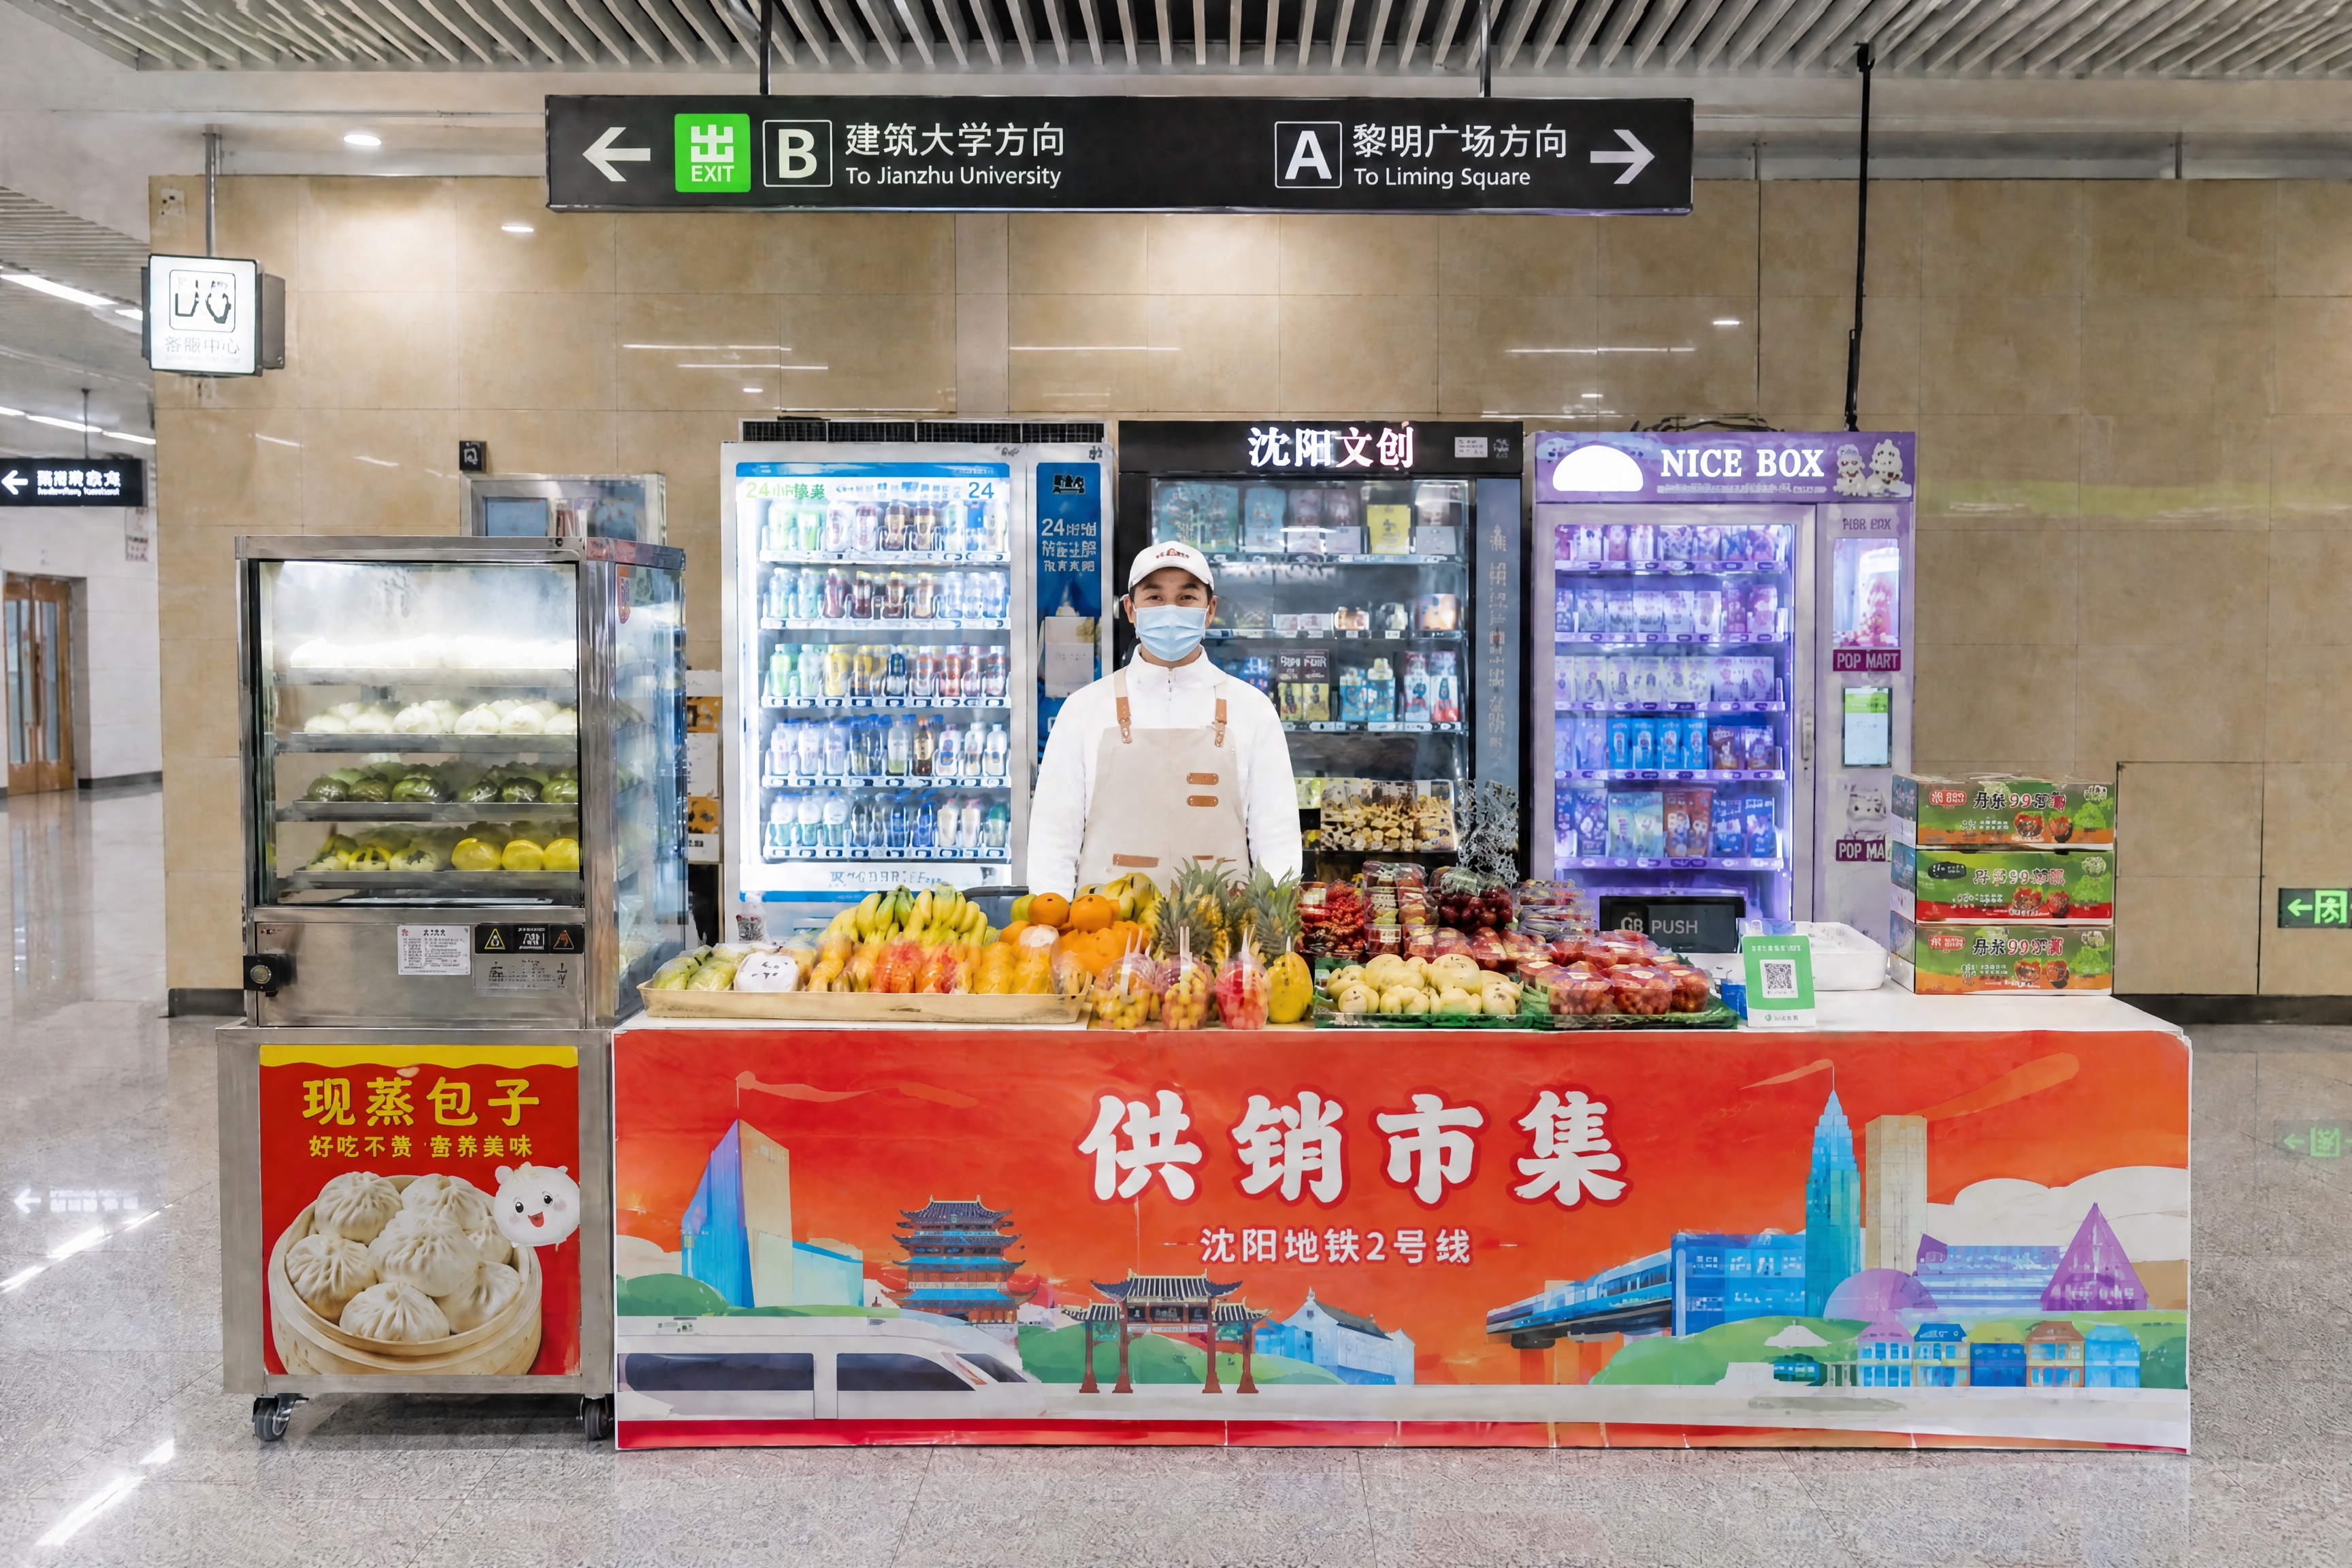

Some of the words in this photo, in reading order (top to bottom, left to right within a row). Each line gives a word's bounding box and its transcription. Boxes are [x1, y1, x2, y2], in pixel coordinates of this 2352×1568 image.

[690, 124, 734, 163] 出
[778, 129, 817, 178] B
[845, 122, 1064, 157] 建筑大学方向
[1284, 130, 1333, 180] A
[1352, 123, 1568, 158] 黎明广场方向
[691, 165, 735, 182] EXIT
[845, 167, 870, 184] To
[877, 165, 953, 184] Jianzhu
[960, 165, 1062, 189] University
[1354, 167, 1379, 185] To
[1386, 167, 1453, 189] Liming
[1461, 167, 1531, 191] Square
[1248, 426, 1414, 469] 沈阳文创
[1661, 448, 1742, 477] NICE
[1756, 448, 1825, 477] BOX
[968, 481, 995, 499] 24
[1838, 653, 1861, 669] POP
[1865, 653, 1899, 669] MART
[1839, 843, 1862, 859] POP
[1651, 919, 1698, 934] PUSH
[302, 1077, 540, 1127] 现蒸包子
[1078, 1089, 1627, 1206] 供销市集
[1200, 1228, 1471, 1264] 沈阳地铁2号线
